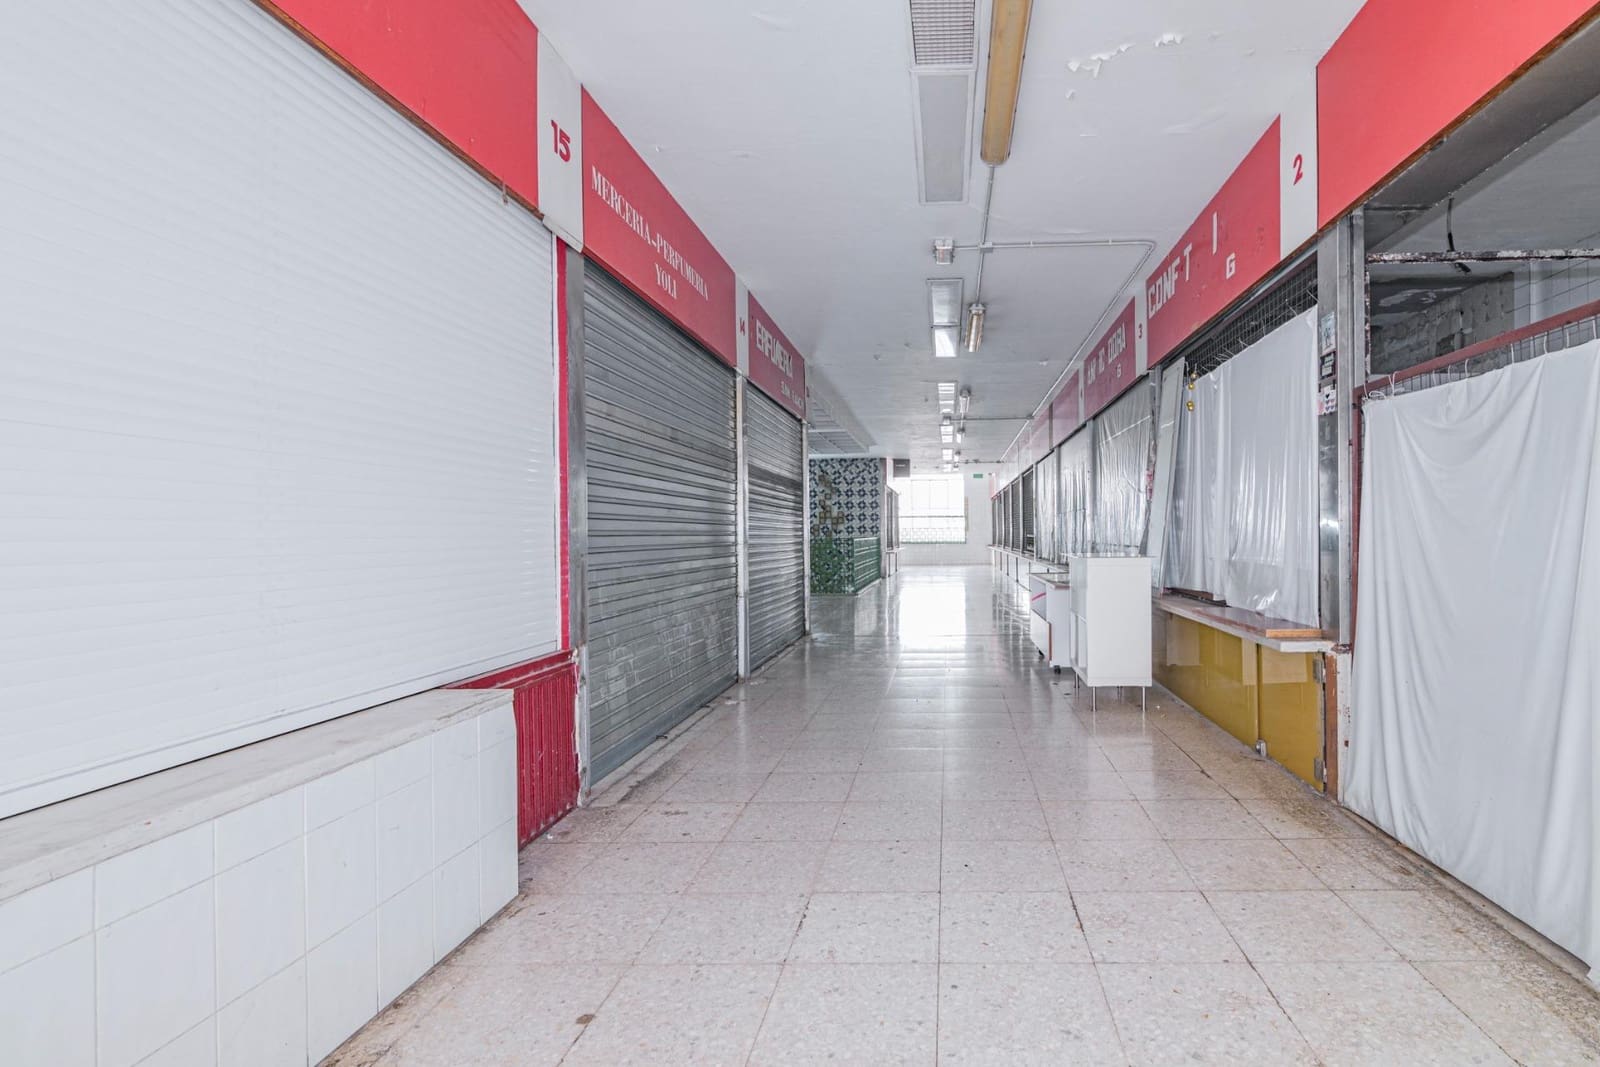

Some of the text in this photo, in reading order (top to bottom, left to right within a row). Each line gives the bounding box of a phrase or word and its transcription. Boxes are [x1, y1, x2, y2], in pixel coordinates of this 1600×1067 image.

[550, 119, 571, 163] 15
[1292, 153, 1304, 187] 2
[654, 262, 678, 300] YOLI
[1225, 252, 1236, 280] G
[1138, 322, 1143, 340] 3
